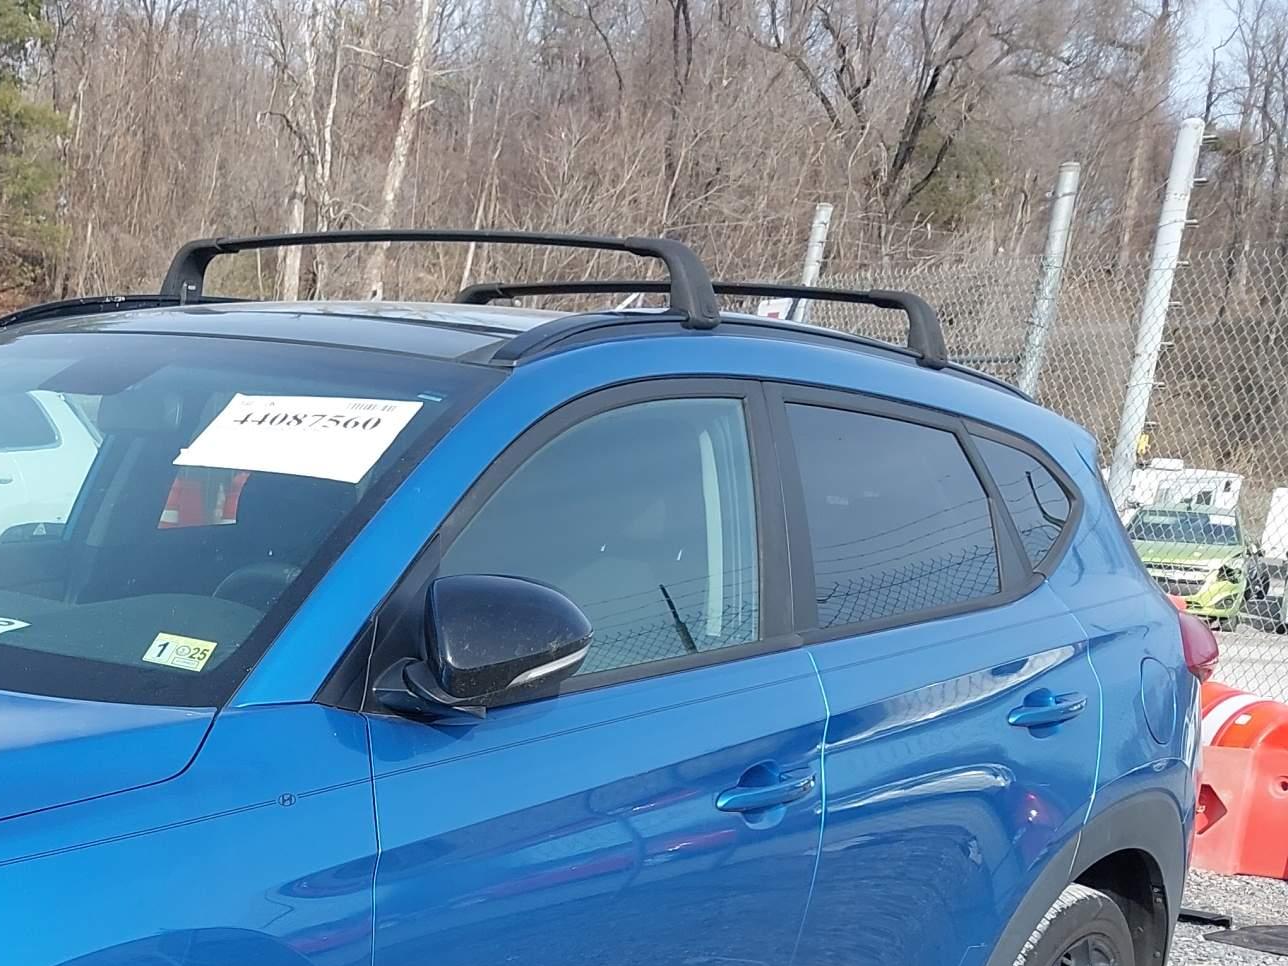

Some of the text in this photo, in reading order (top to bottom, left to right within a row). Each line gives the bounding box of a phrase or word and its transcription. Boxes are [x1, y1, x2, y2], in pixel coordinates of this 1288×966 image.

[233, 412, 382, 430] 44087560
[156, 642, 210, 660] 1 25
